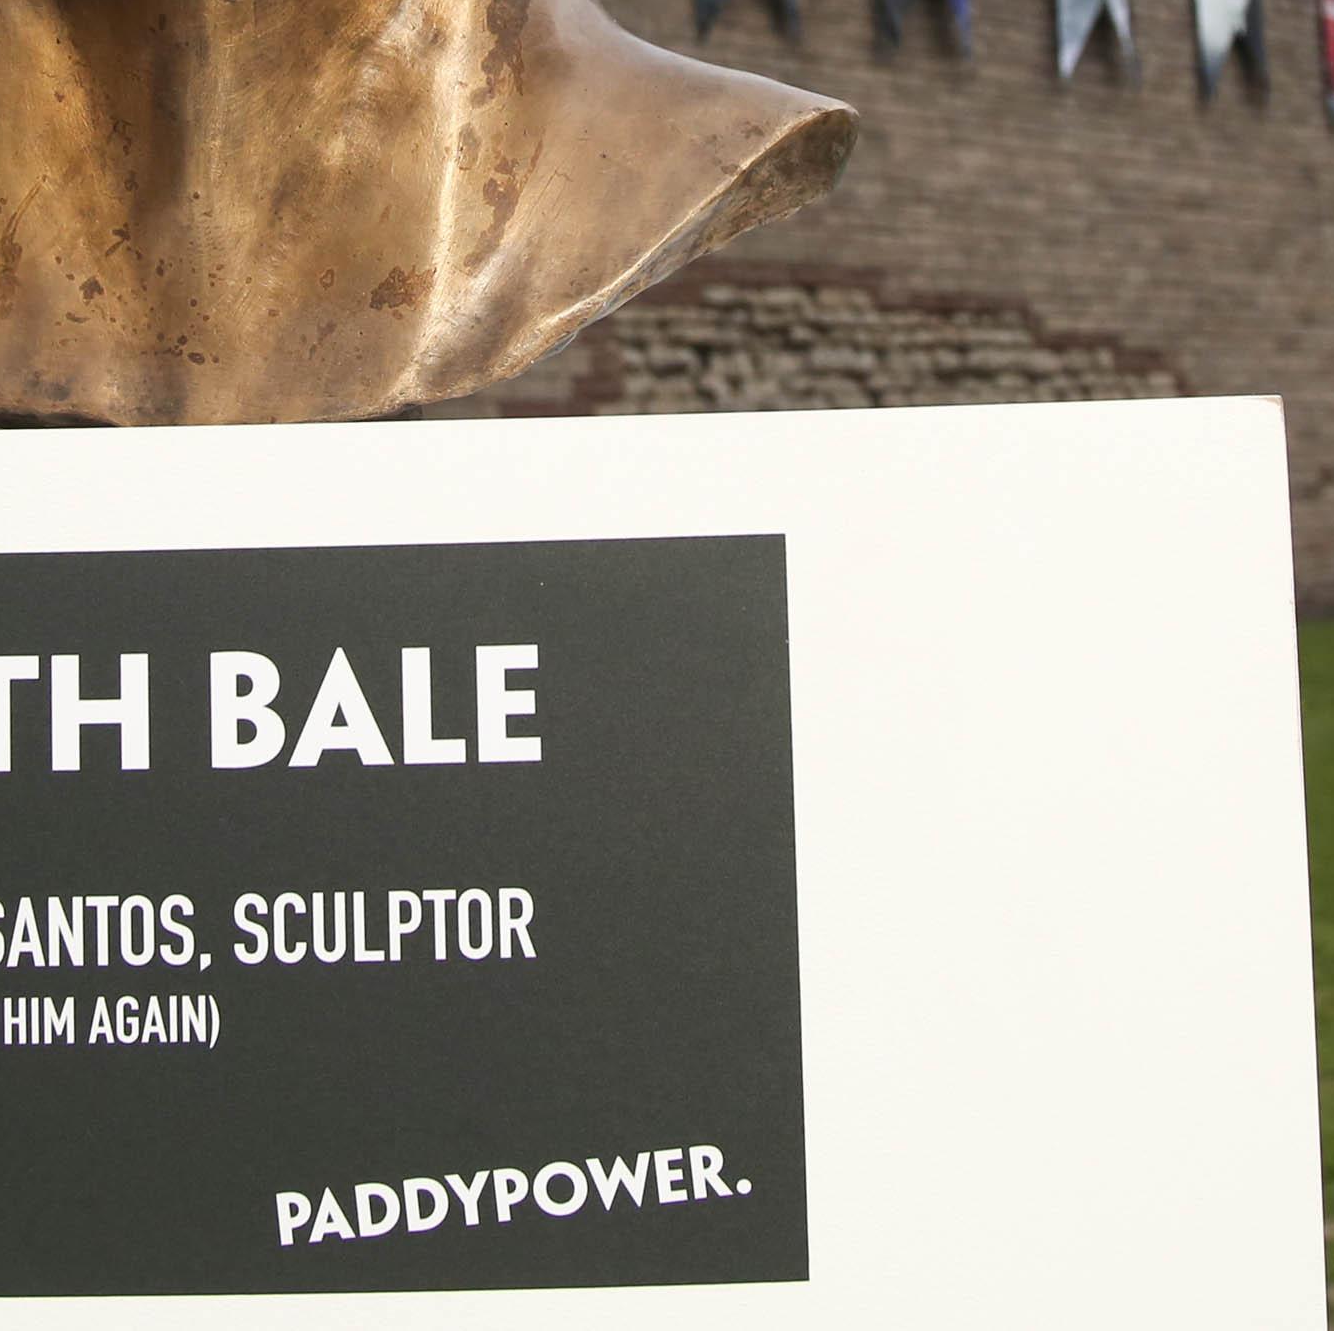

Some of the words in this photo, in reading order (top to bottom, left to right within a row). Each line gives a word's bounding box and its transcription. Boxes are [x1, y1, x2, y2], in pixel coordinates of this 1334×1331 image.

[208, 643, 543, 770] BALE
[232, 886, 538, 966] SCULPTOR
[2, 995, 76, 1047] HIM
[87, 993, 221, 1050] AGAIN)
[274, 1143, 753, 1247] PADDYPOWER.
